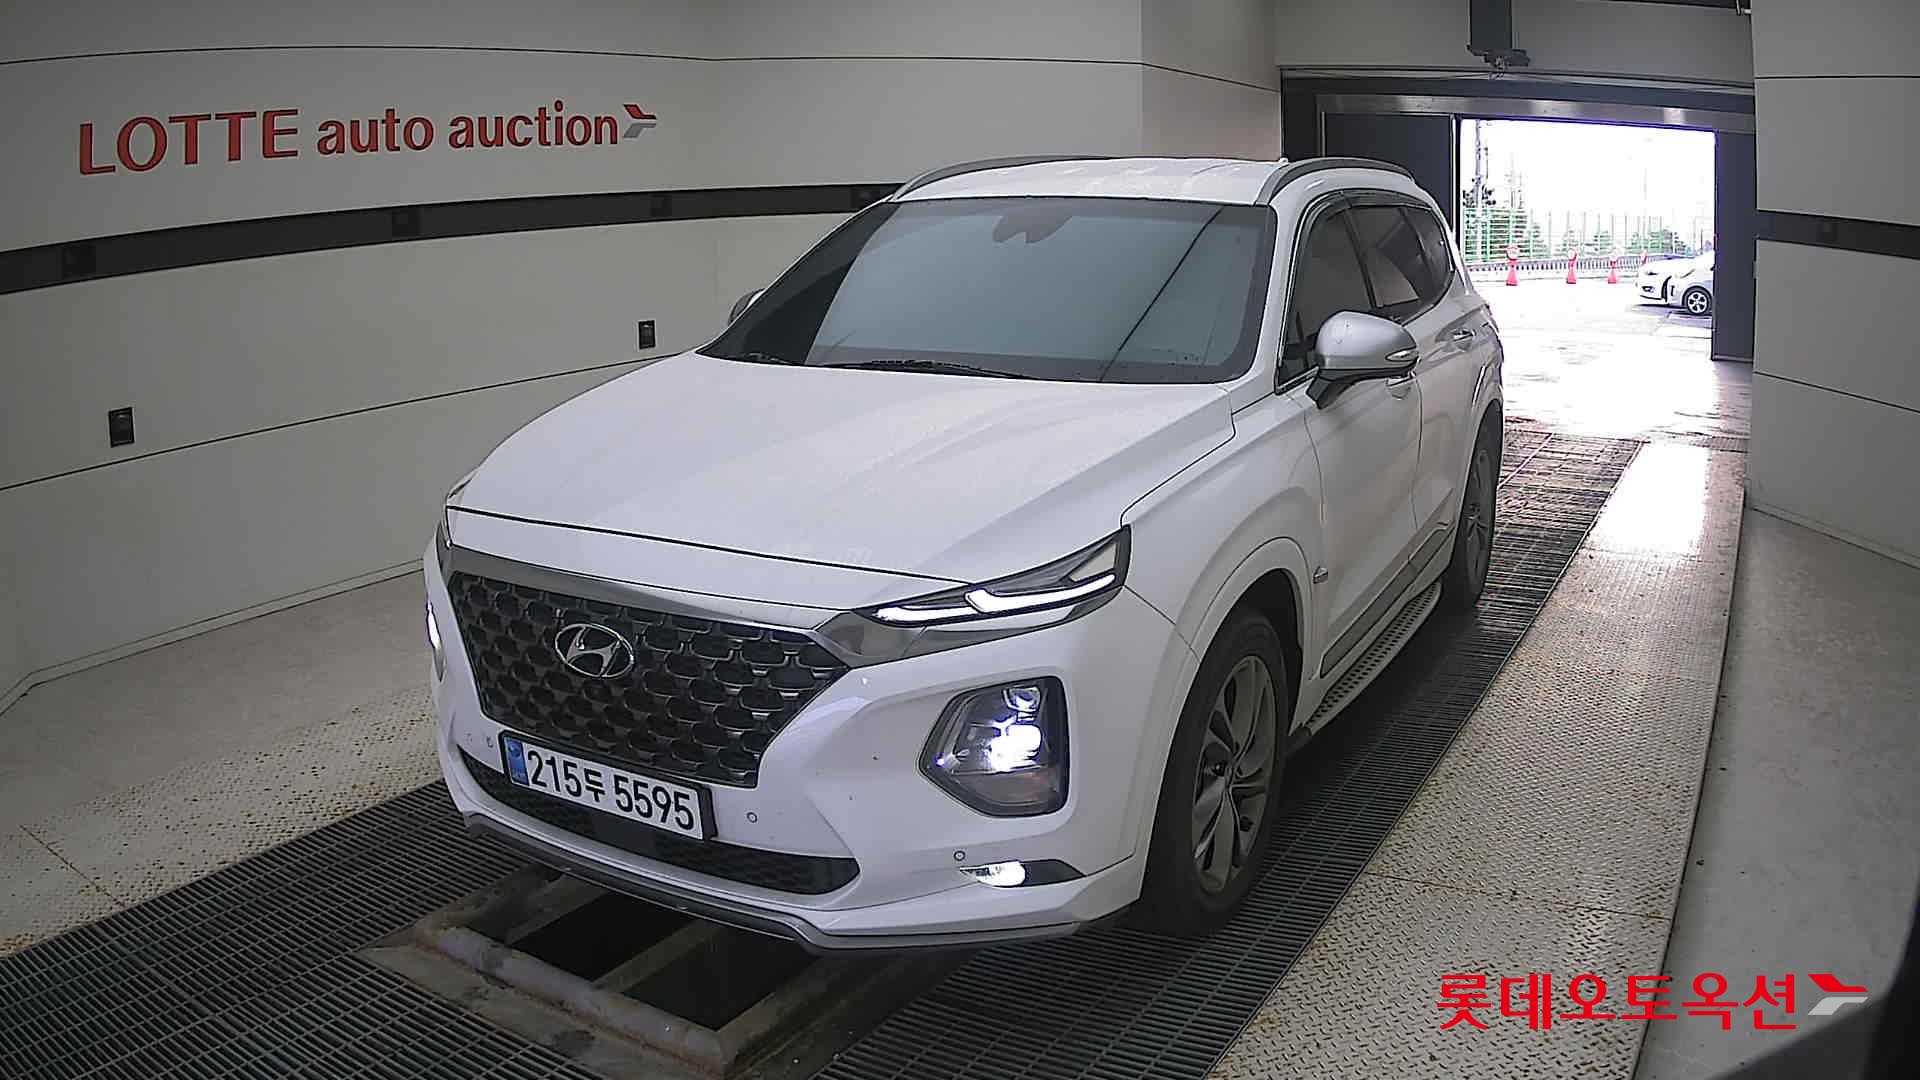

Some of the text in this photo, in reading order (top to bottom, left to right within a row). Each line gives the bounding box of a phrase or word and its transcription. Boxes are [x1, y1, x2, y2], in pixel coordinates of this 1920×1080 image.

[79, 100, 619, 175] LOTTE auto auction
[527, 750, 694, 831] 215두 5595
